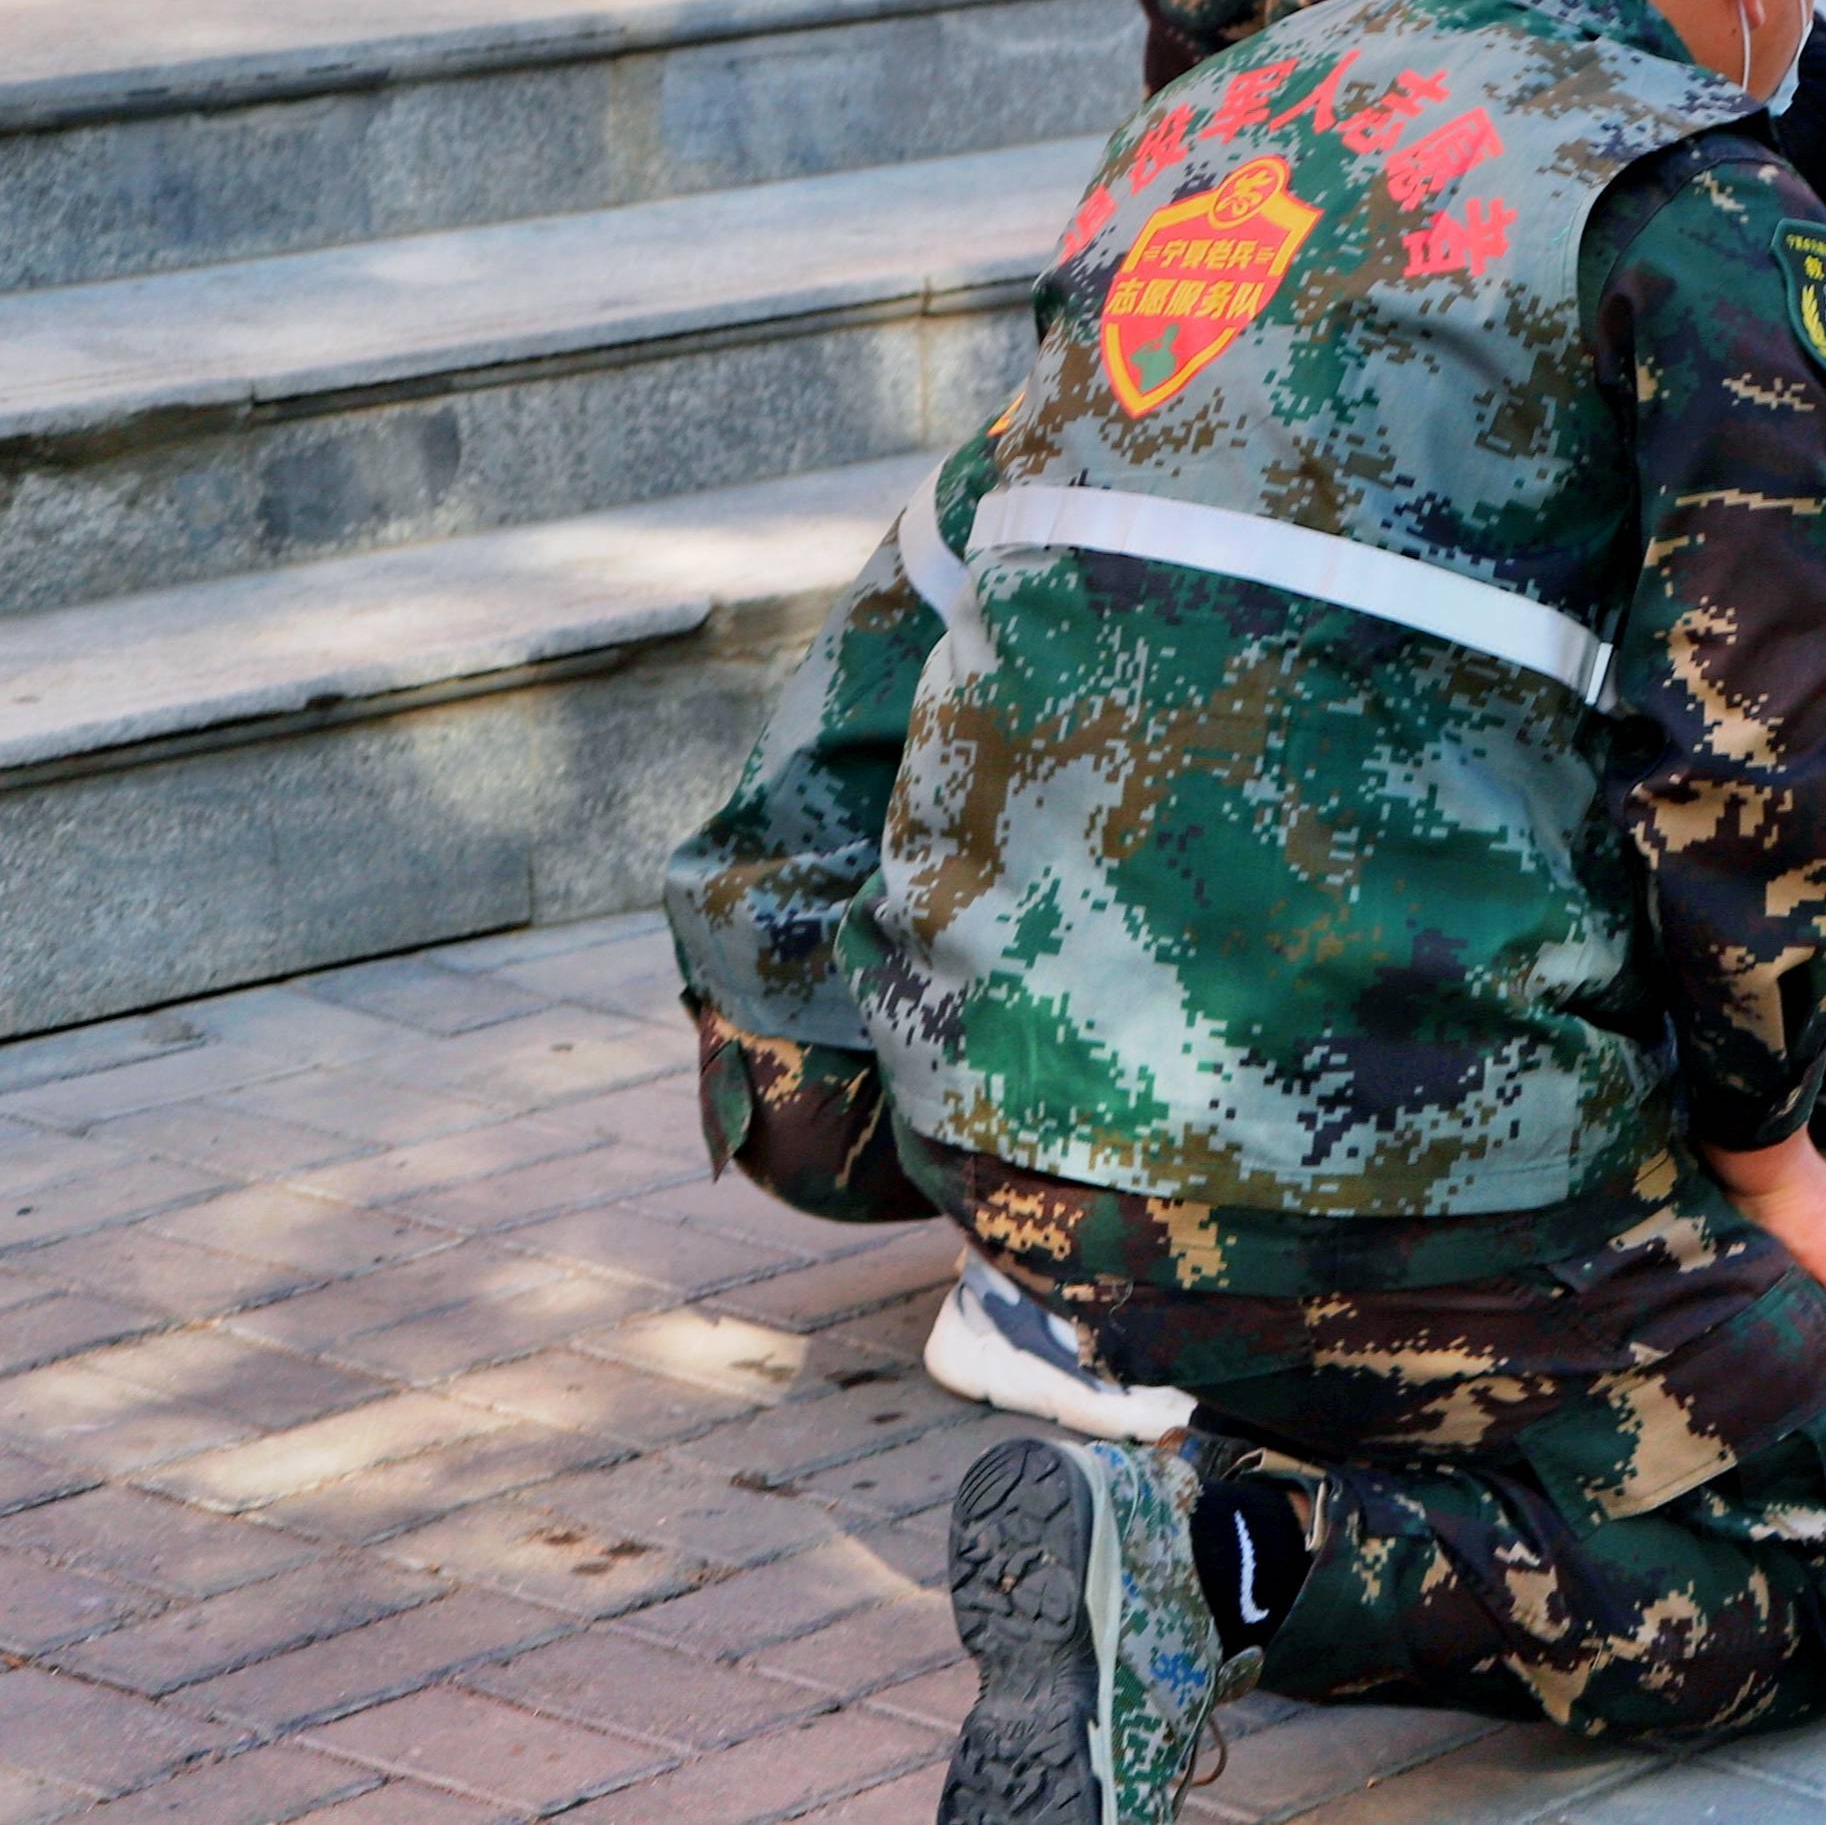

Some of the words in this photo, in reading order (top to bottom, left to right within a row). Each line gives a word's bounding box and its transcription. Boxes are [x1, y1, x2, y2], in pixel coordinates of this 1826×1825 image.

[1056, 48, 1519, 278] 退役军人志愿者
[1105, 277, 1265, 320] 志愿服务队
